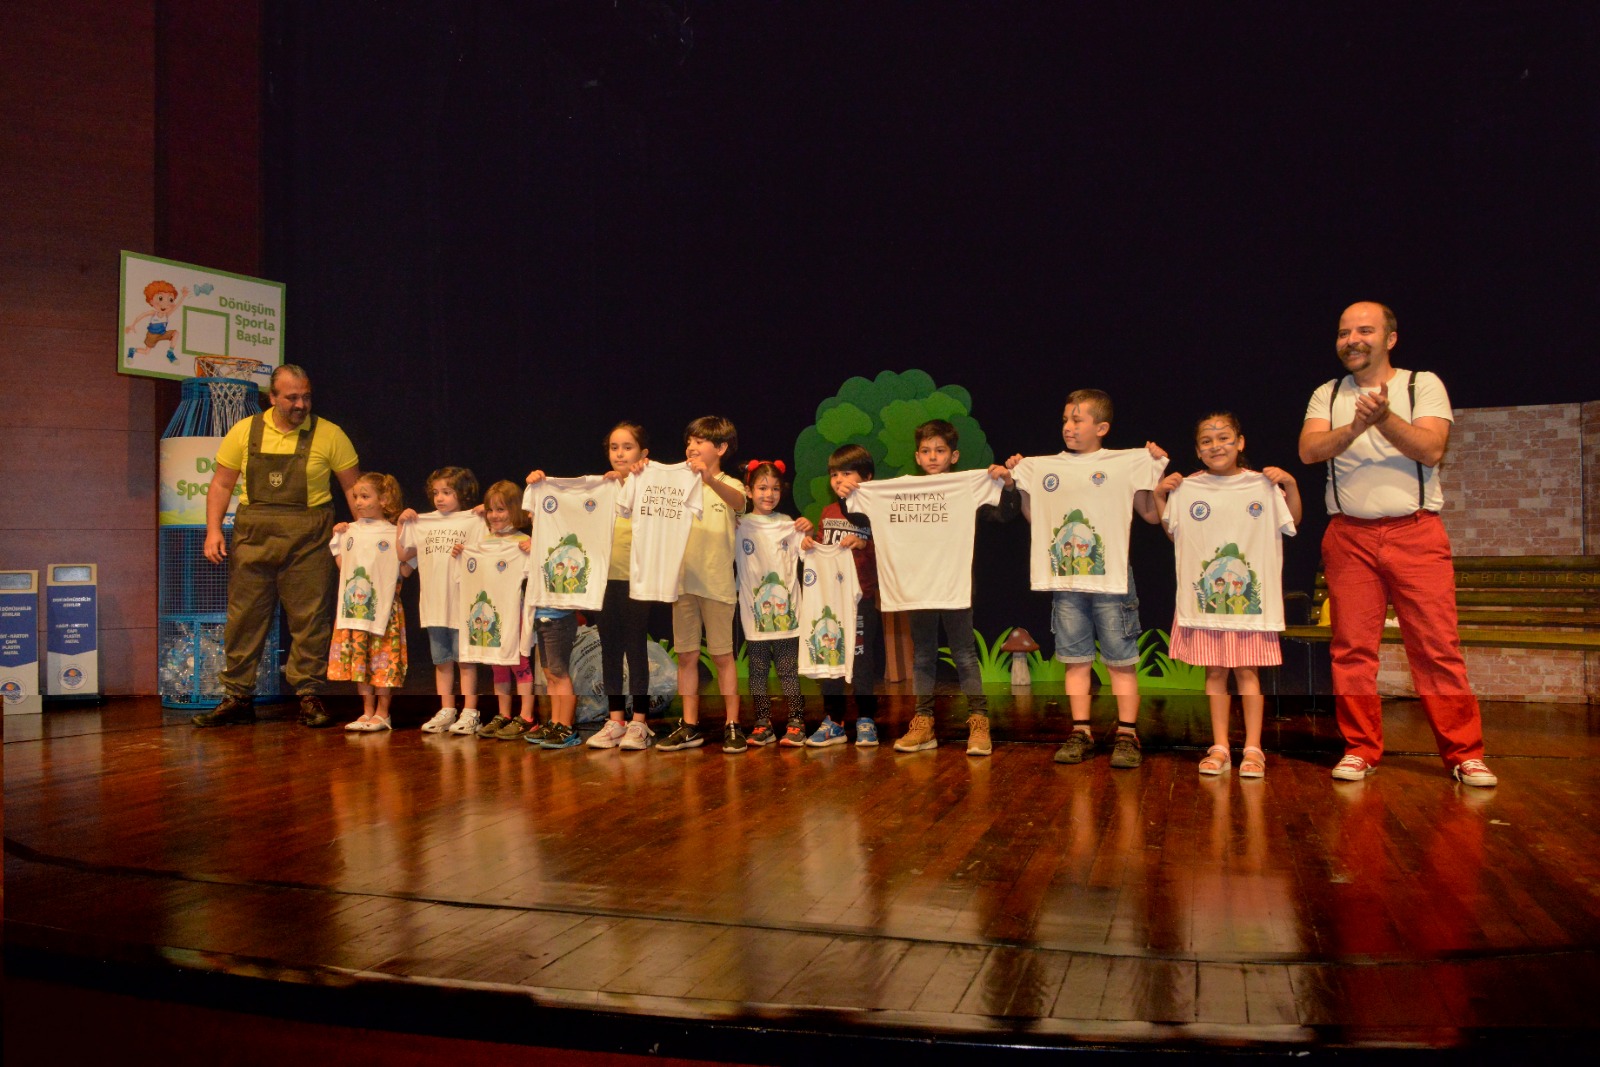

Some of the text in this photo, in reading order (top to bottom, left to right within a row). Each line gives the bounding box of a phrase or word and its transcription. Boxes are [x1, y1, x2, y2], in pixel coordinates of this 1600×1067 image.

[219, 296, 276, 317] Dönüşüm
[235, 314, 275, 331] Sporla
[236, 329, 275, 347] Başlar
[644, 485, 685, 497] ATIKTAN
[894, 492, 945, 501] ATIKTAN
[890, 501, 947, 512] ÜRETMEK
[428, 529, 467, 538] ATIKTAN
